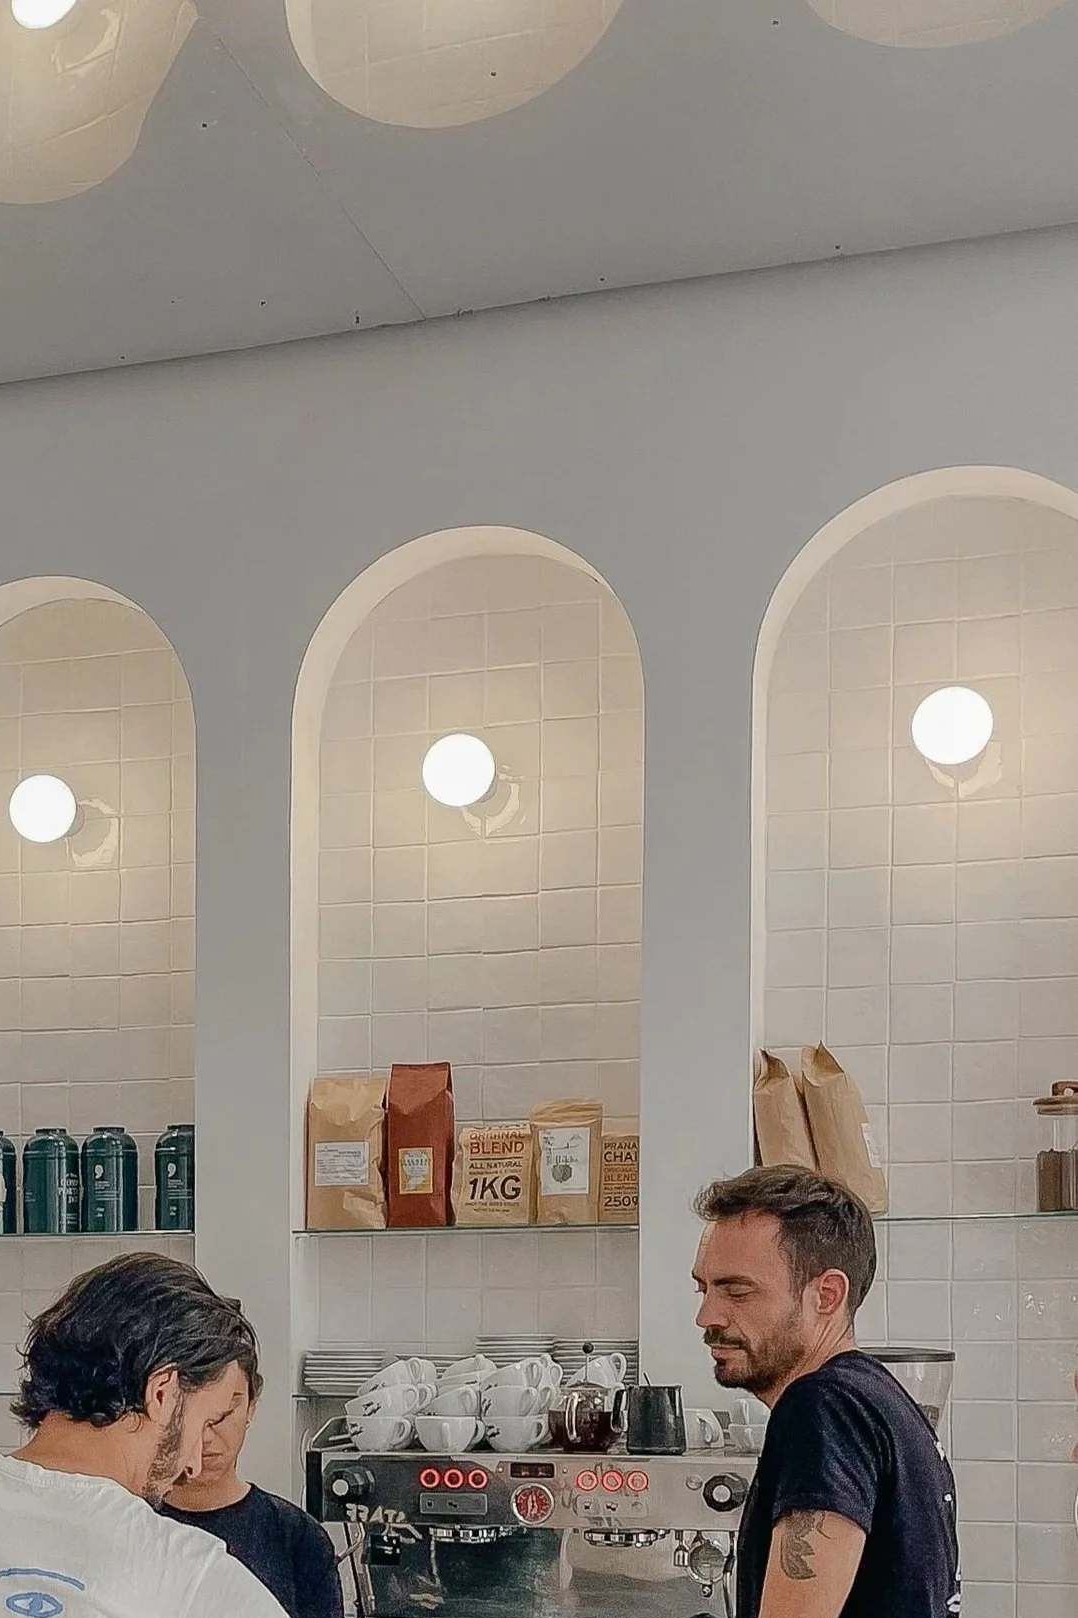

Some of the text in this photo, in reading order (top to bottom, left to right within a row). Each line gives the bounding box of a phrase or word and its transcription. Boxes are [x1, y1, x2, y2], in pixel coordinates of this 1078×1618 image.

[470, 1141, 524, 1154] BLEND
[604, 1142, 637, 1150] PRANA
[604, 1151, 637, 1162] CHAI
[469, 1161, 522, 1170] ALL NATURAL
[469, 1175, 521, 1200] 1KG
